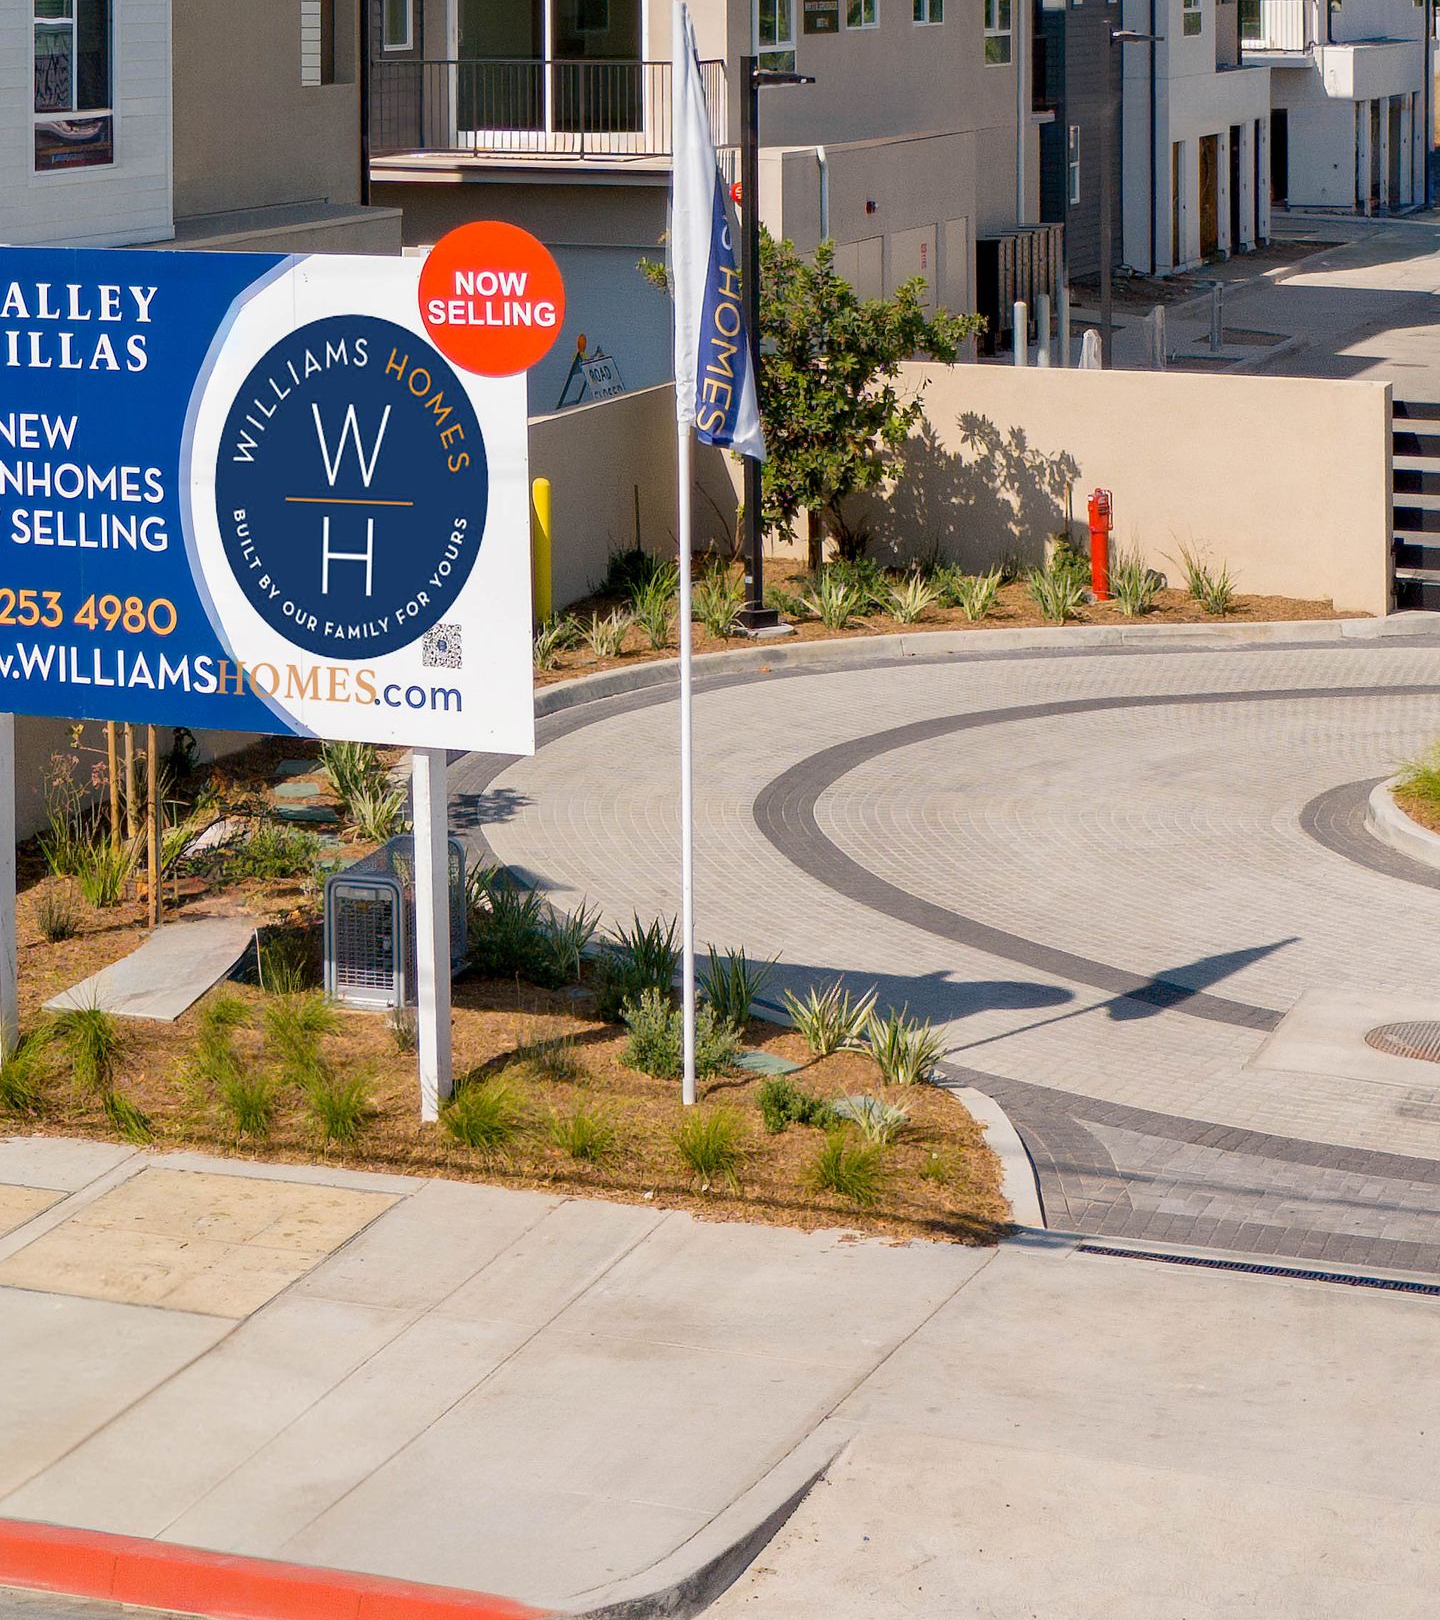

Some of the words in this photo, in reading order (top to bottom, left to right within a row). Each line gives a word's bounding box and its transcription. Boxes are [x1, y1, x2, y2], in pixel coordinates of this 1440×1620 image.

[428, 300, 556, 328] SELLING
[455, 271, 527, 297] NOW
[589, 365, 613, 383] ROAD
[696, 265, 742, 434] HOMES
[233, 337, 369, 463] WILLIAMS
[385, 347, 470, 473] HOMES
[311, 402, 392, 488] W
[10, 509, 169, 553] SELLING
[321, 515, 374, 597] H
[233, 508, 262, 570] BUILT
[258, 573, 281, 599] BY
[282, 601, 318, 632] OUR
[324, 617, 391, 640] FAMILY
[395, 590, 431, 626] FOR
[429, 516, 468, 588] YOURS
[74, 595, 178, 636] 4980
